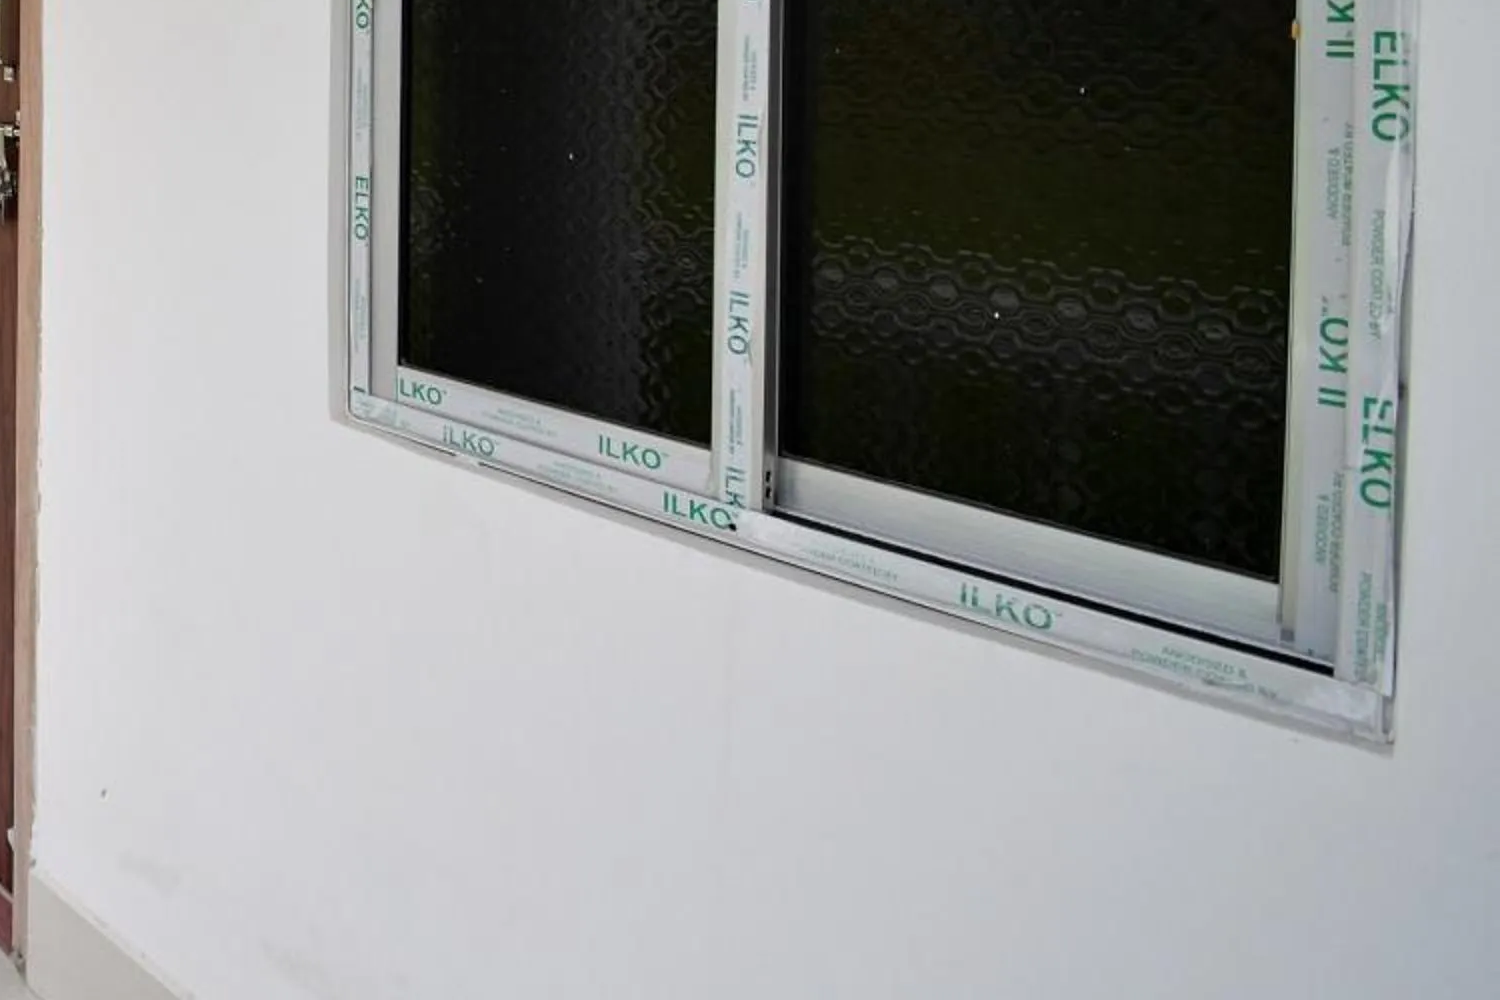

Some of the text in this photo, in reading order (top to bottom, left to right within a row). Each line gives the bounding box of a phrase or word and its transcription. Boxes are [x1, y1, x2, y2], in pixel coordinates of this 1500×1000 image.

[1371, 31, 1411, 142] ELKO
[735, 113, 758, 179] ILKO
[354, 175, 369, 241] ELKO
[727, 289, 750, 356] ILKO
[400, 378, 442, 405] LKO
[443, 424, 496, 456] ILKO
[599, 434, 662, 471] ILKO
[1360, 396, 1394, 508] ELKO
[664, 491, 732, 530] ILKO
[959, 581, 1053, 630] ILKO
